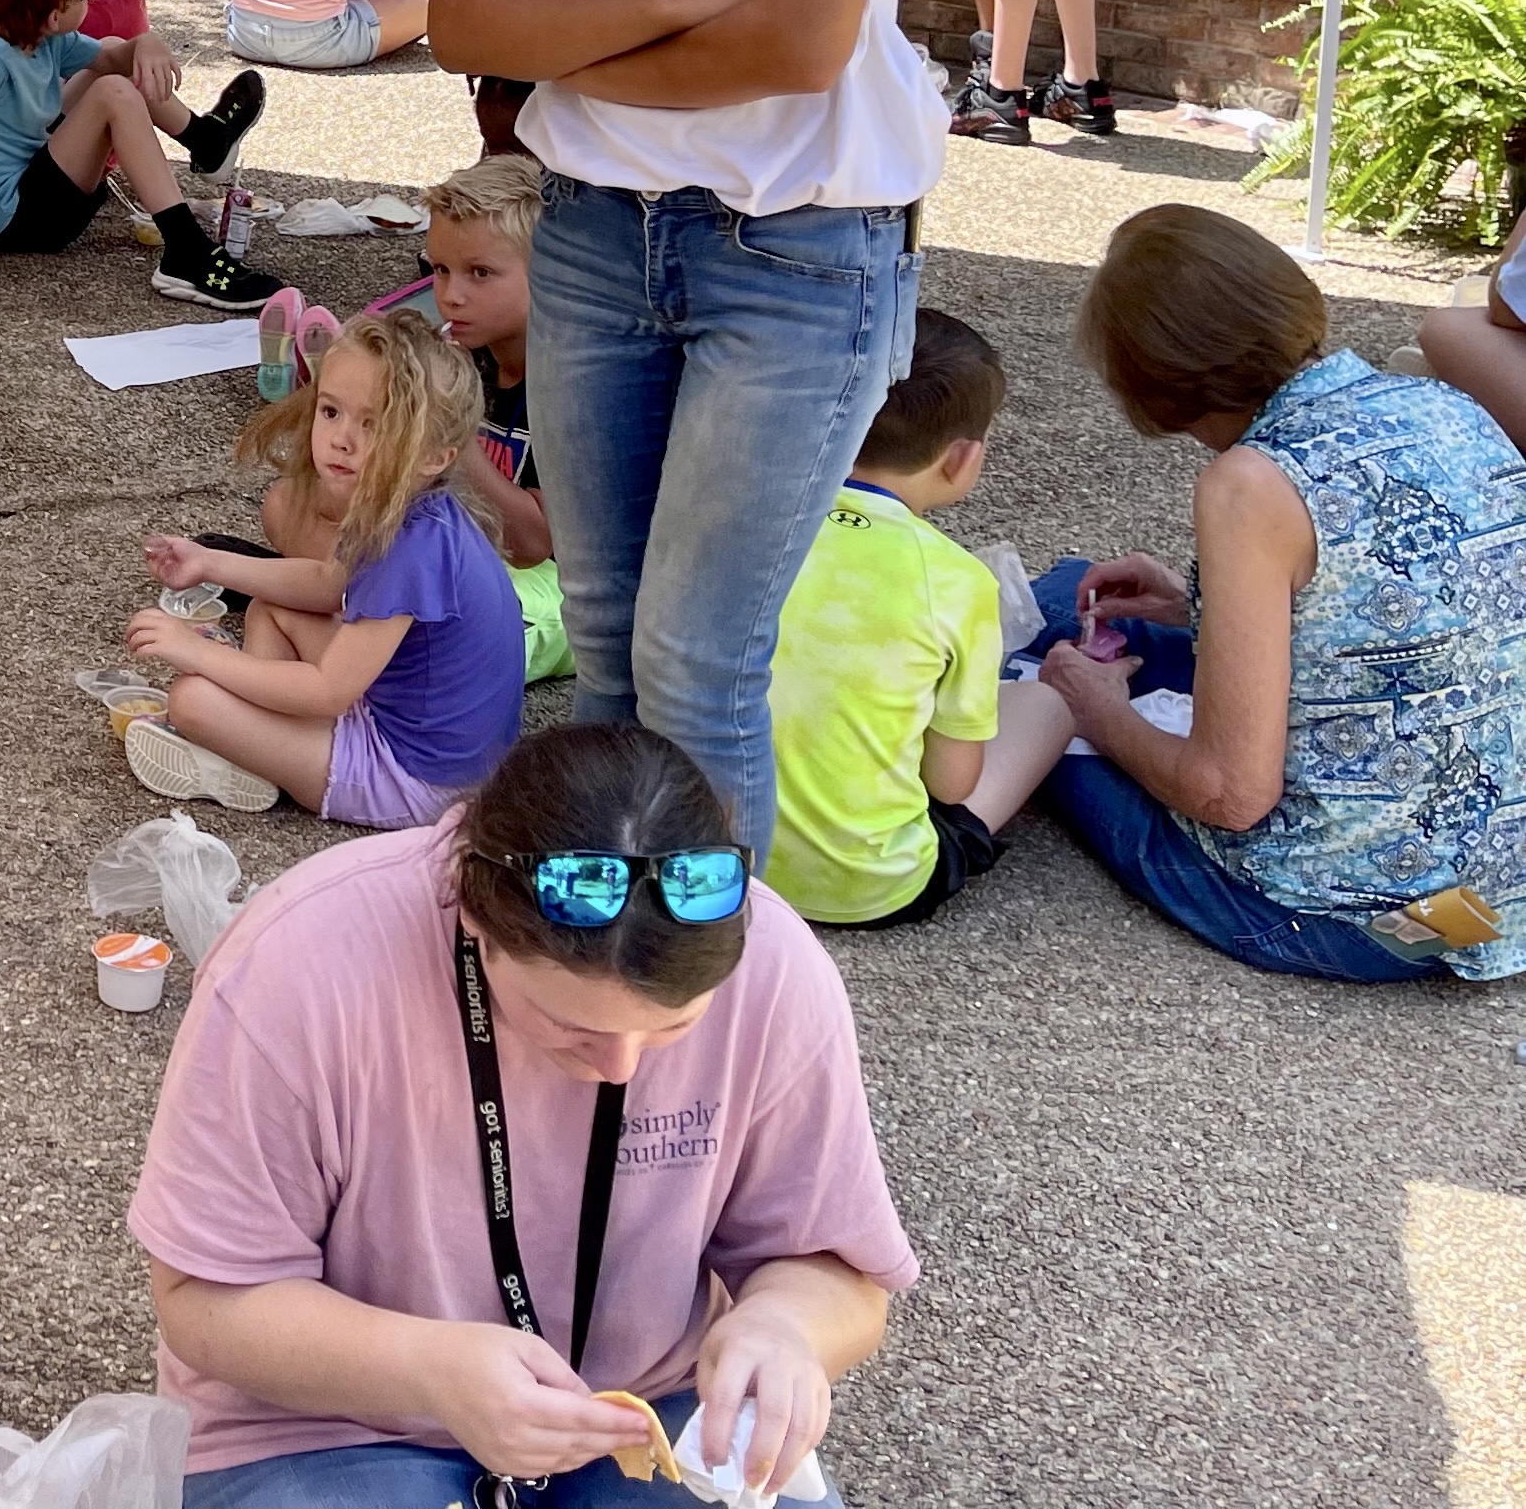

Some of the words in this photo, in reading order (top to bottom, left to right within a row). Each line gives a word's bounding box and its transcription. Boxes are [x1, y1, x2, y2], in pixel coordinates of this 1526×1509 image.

[463, 953, 490, 1044] senioritis?
[479, 1100, 502, 1135] got
[631, 1101, 717, 1136] simply
[488, 1138, 510, 1221] senioritis?
[502, 1273, 526, 1310] got
